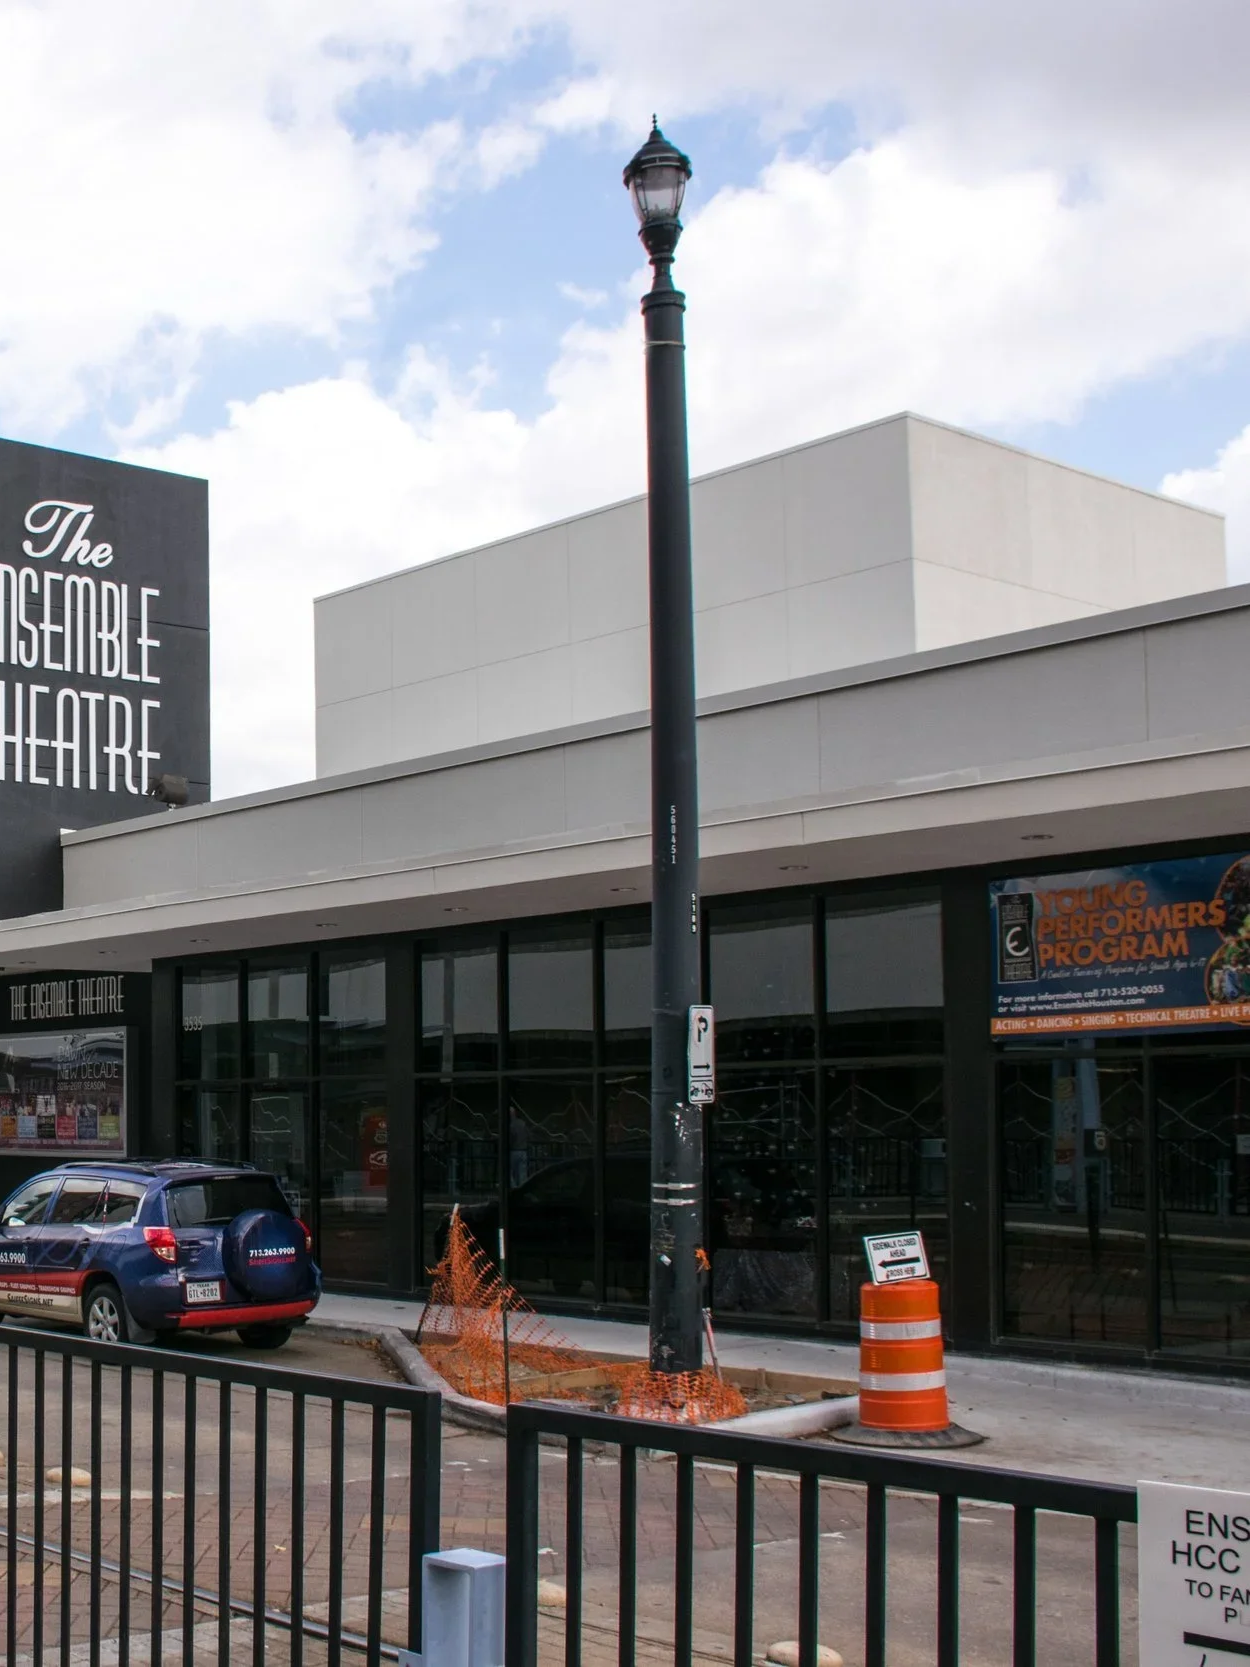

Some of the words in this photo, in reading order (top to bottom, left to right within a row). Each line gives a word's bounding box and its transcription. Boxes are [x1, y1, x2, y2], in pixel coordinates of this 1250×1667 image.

[22, 500, 114, 568] The
[1036, 880, 1147, 914] YOUNG
[1037, 899, 1227, 942] PERFORMERS
[1037, 930, 1189, 967] PROGRAM
[9, 985, 28, 1020] THE
[30, 980, 75, 1019] ENSEMBLE
[77, 975, 125, 1015] THEATRE
[997, 995, 1013, 1004] For
[1014, 993, 1036, 1003] more
[1037, 990, 1082, 1001] information
[1084, 988, 1098, 999] call
[1100, 984, 1165, 998] 713-520-0055
[997, 1005, 1009, 1013] or
[1010, 1003, 1027, 1013] visit
[1029, 996, 1145, 1012] www.EnsembleHouston.com
[184, 1016, 203, 1031] 3535
[996, 1020, 1028, 1031] ACTING
[1036, 1017, 1073, 1029] DANCING
[1081, 1014, 1116, 1026] SINGING
[1125, 1010, 1171, 1023] TECHNICAL
[1173, 1008, 1211, 1020] THEATRE
[1220, 1006, 1239, 1017] LIVE
[57, 1063, 78, 1080] NEW
[81, 1061, 119, 1079] DECADE
[84, 1081, 106, 1090] SEASON
[249, 1246, 296, 1257] 713.263.9900
[872, 1240, 897, 1251] SIDEWALK
[897, 1237, 917, 1247] CLOSED
[889, 1248, 906, 1258] AHEAD
[1171, 1540, 1241, 1574] HCC
[1184, 1578, 1213, 1598] TO
